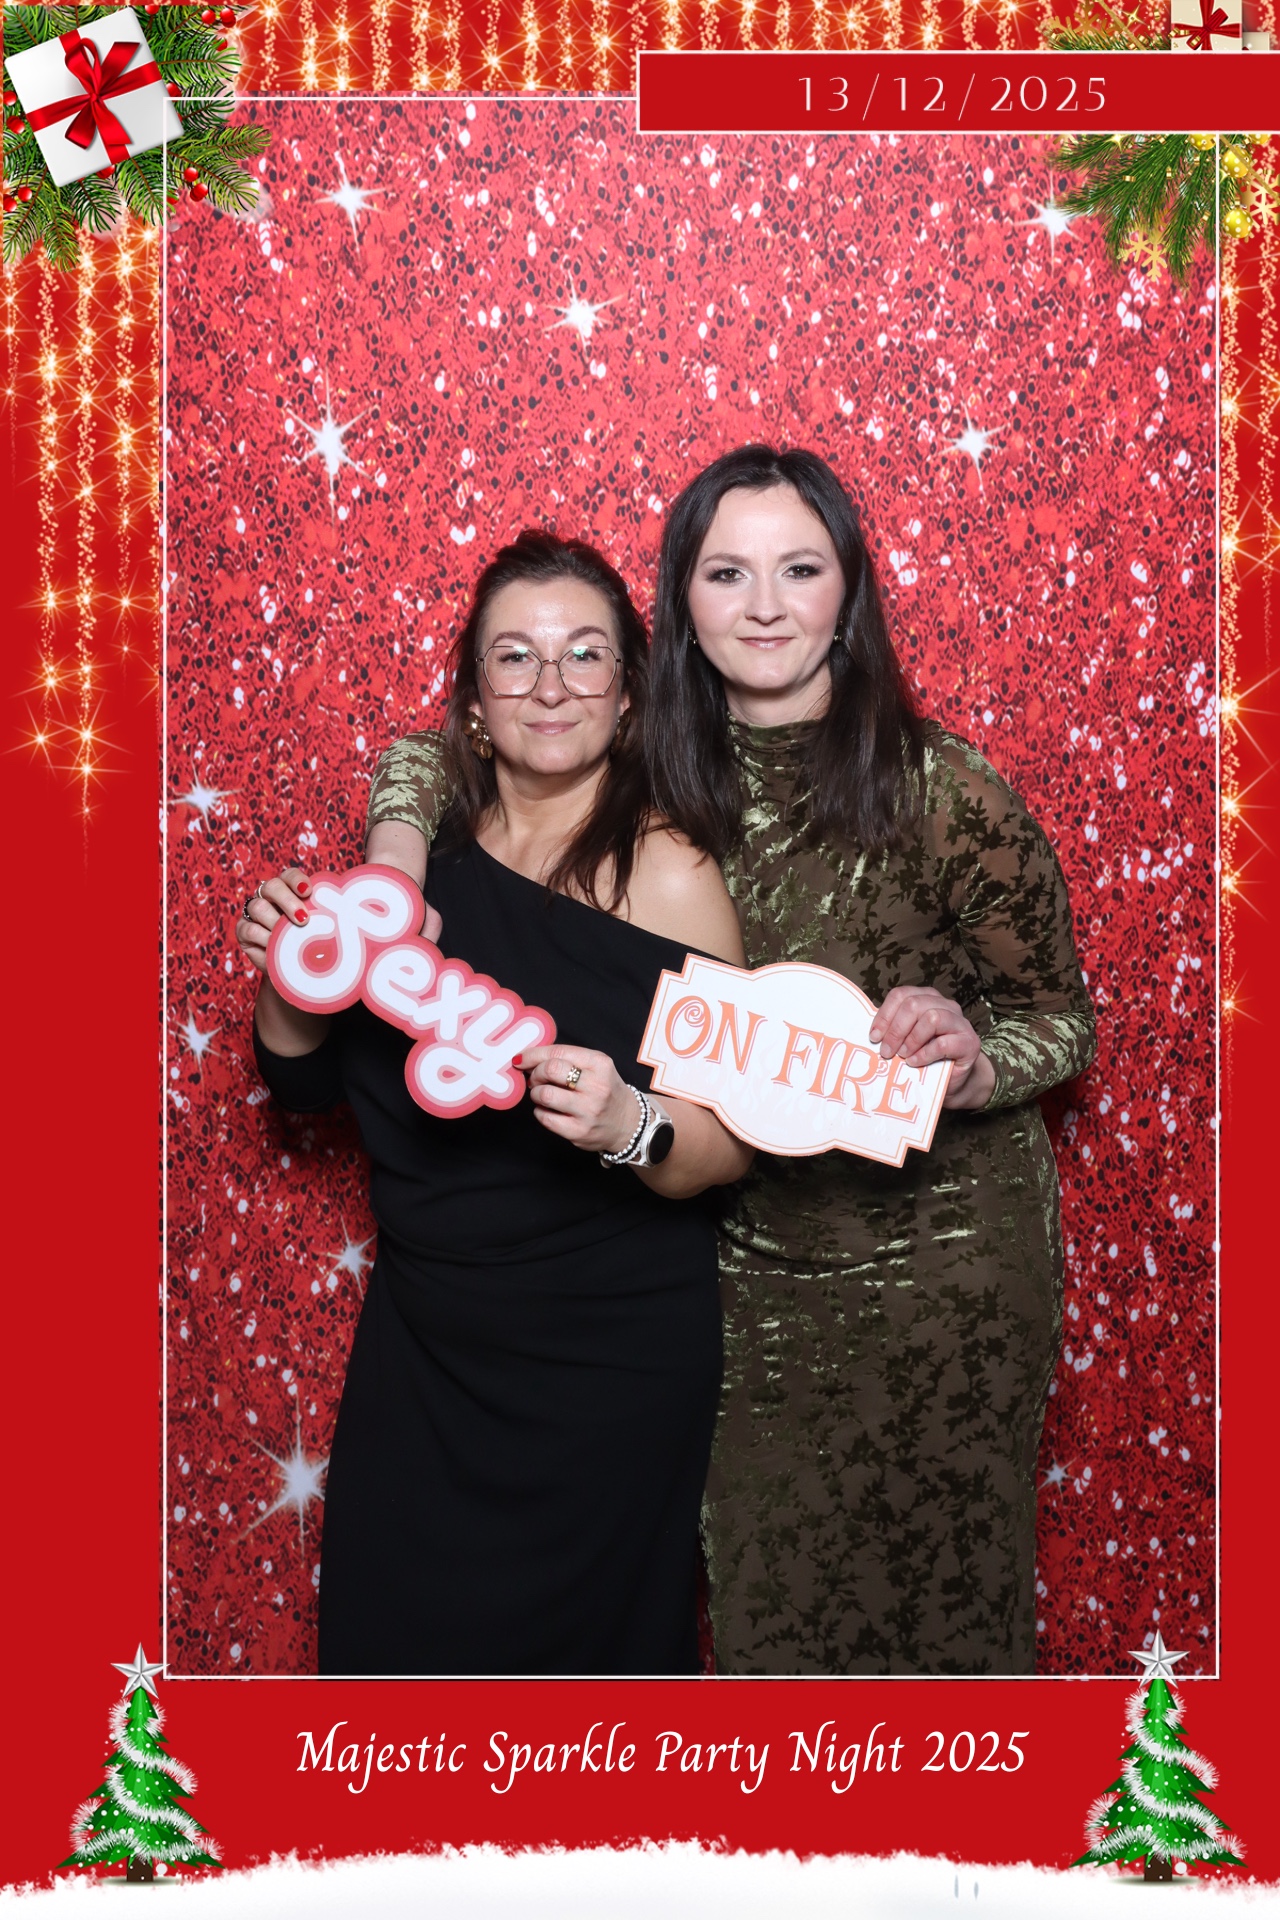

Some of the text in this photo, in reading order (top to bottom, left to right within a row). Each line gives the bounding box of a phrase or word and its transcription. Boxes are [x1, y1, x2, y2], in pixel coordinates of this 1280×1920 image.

[273, 876, 547, 1105] Sexy
[664, 995, 929, 1124] ON FIRE
